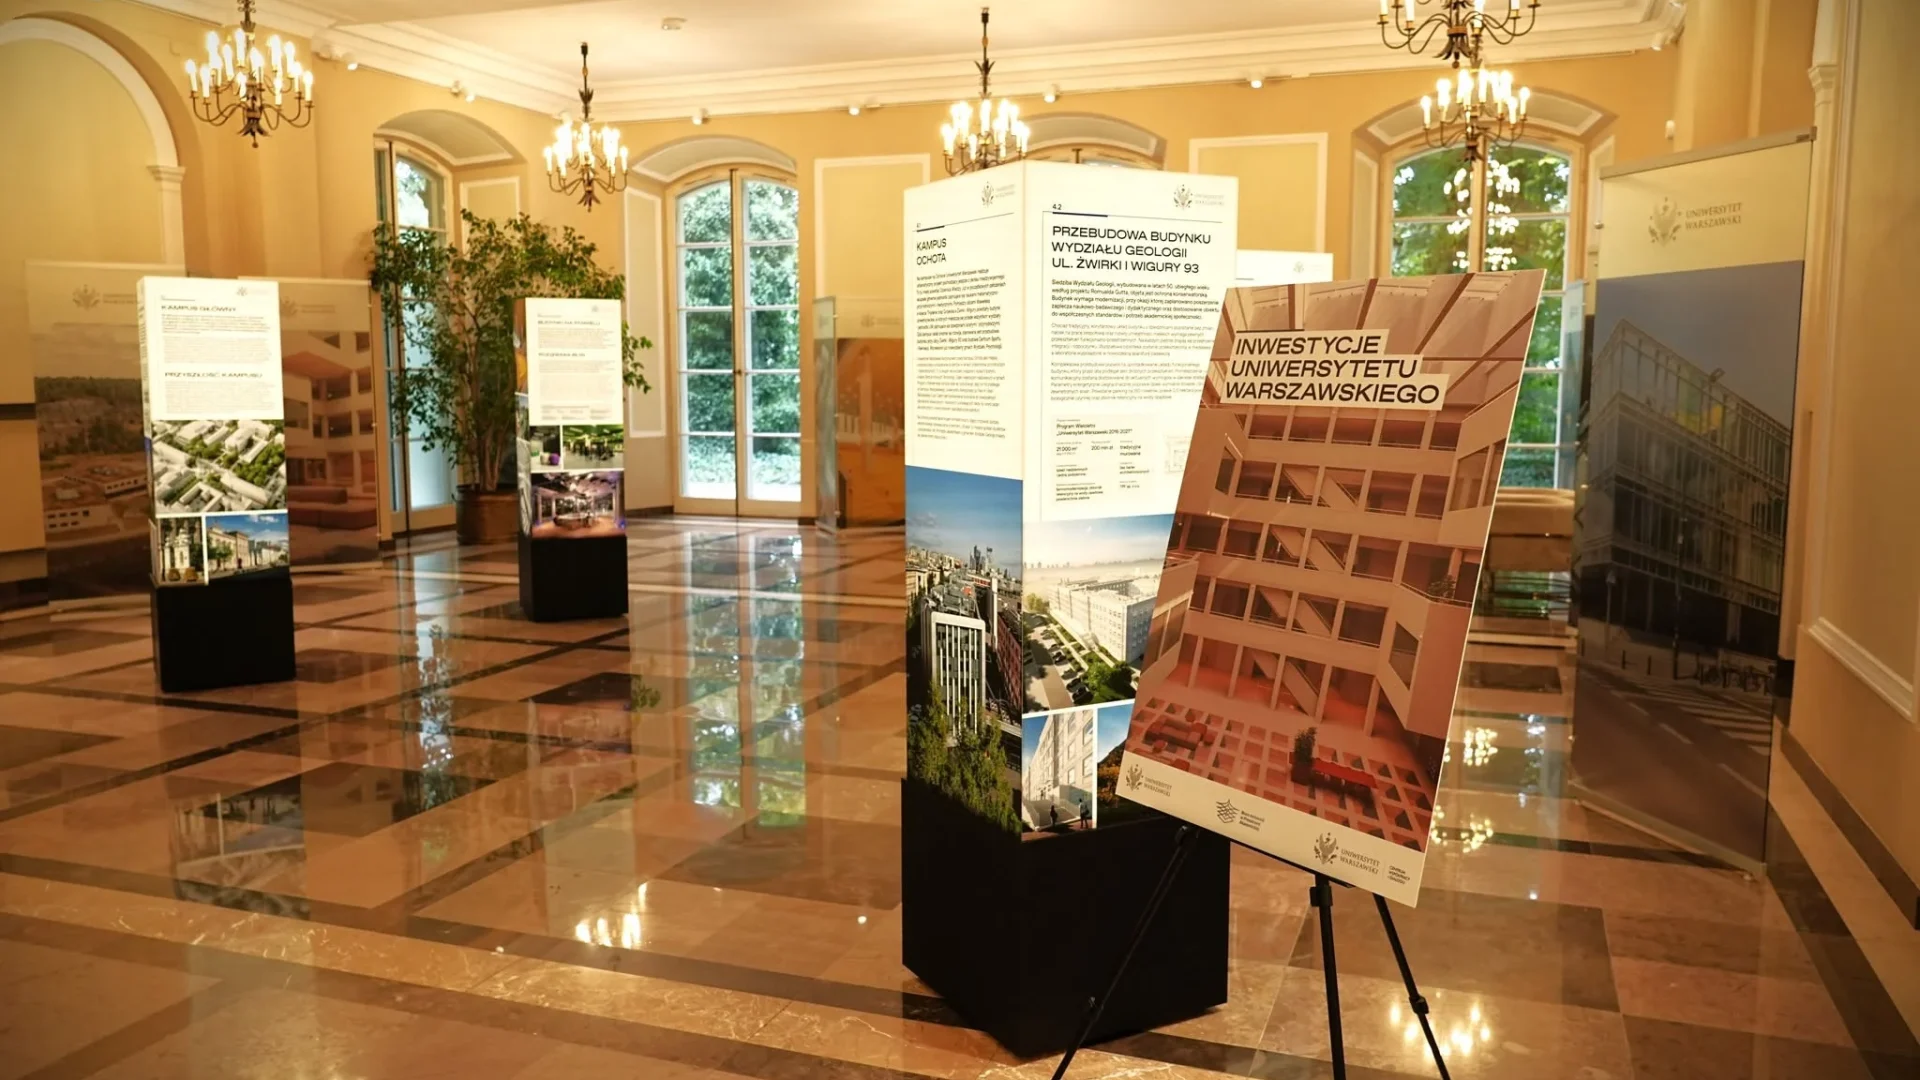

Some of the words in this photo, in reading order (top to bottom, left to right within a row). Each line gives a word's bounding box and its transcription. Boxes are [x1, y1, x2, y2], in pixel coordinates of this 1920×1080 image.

[1685, 202, 1742, 218] UNIWERSYTET
[1685, 216, 1741, 230] WARSZAWSKI
[1052, 226, 1147, 241] PRZEBUDOWA
[1151, 231, 1211, 244] BUDYNKU
[916, 238, 947, 251] KAMPUS
[1052, 242, 1122, 255] WYDZIAŁU
[1125, 245, 1187, 258] GEOLOGII
[916, 253, 946, 265] OCHOTA
[1052, 258, 1073, 269] UL.
[1076, 256, 1121, 270] ŻWIRKI
[1124, 260, 1128, 270] I
[1130, 261, 1180, 273] WIGURY
[1184, 263, 1199, 273] 93
[1236, 335, 1381, 355] INWESTYCJE
[1231, 359, 1417, 378] UNIWERSYTETU
[1225, 382, 1439, 403] WARSZAWSKIEGO
[1339, 856, 1379, 875] WARSZAWSKI
[1340, 848, 1381, 867] UNIWERSYTET
